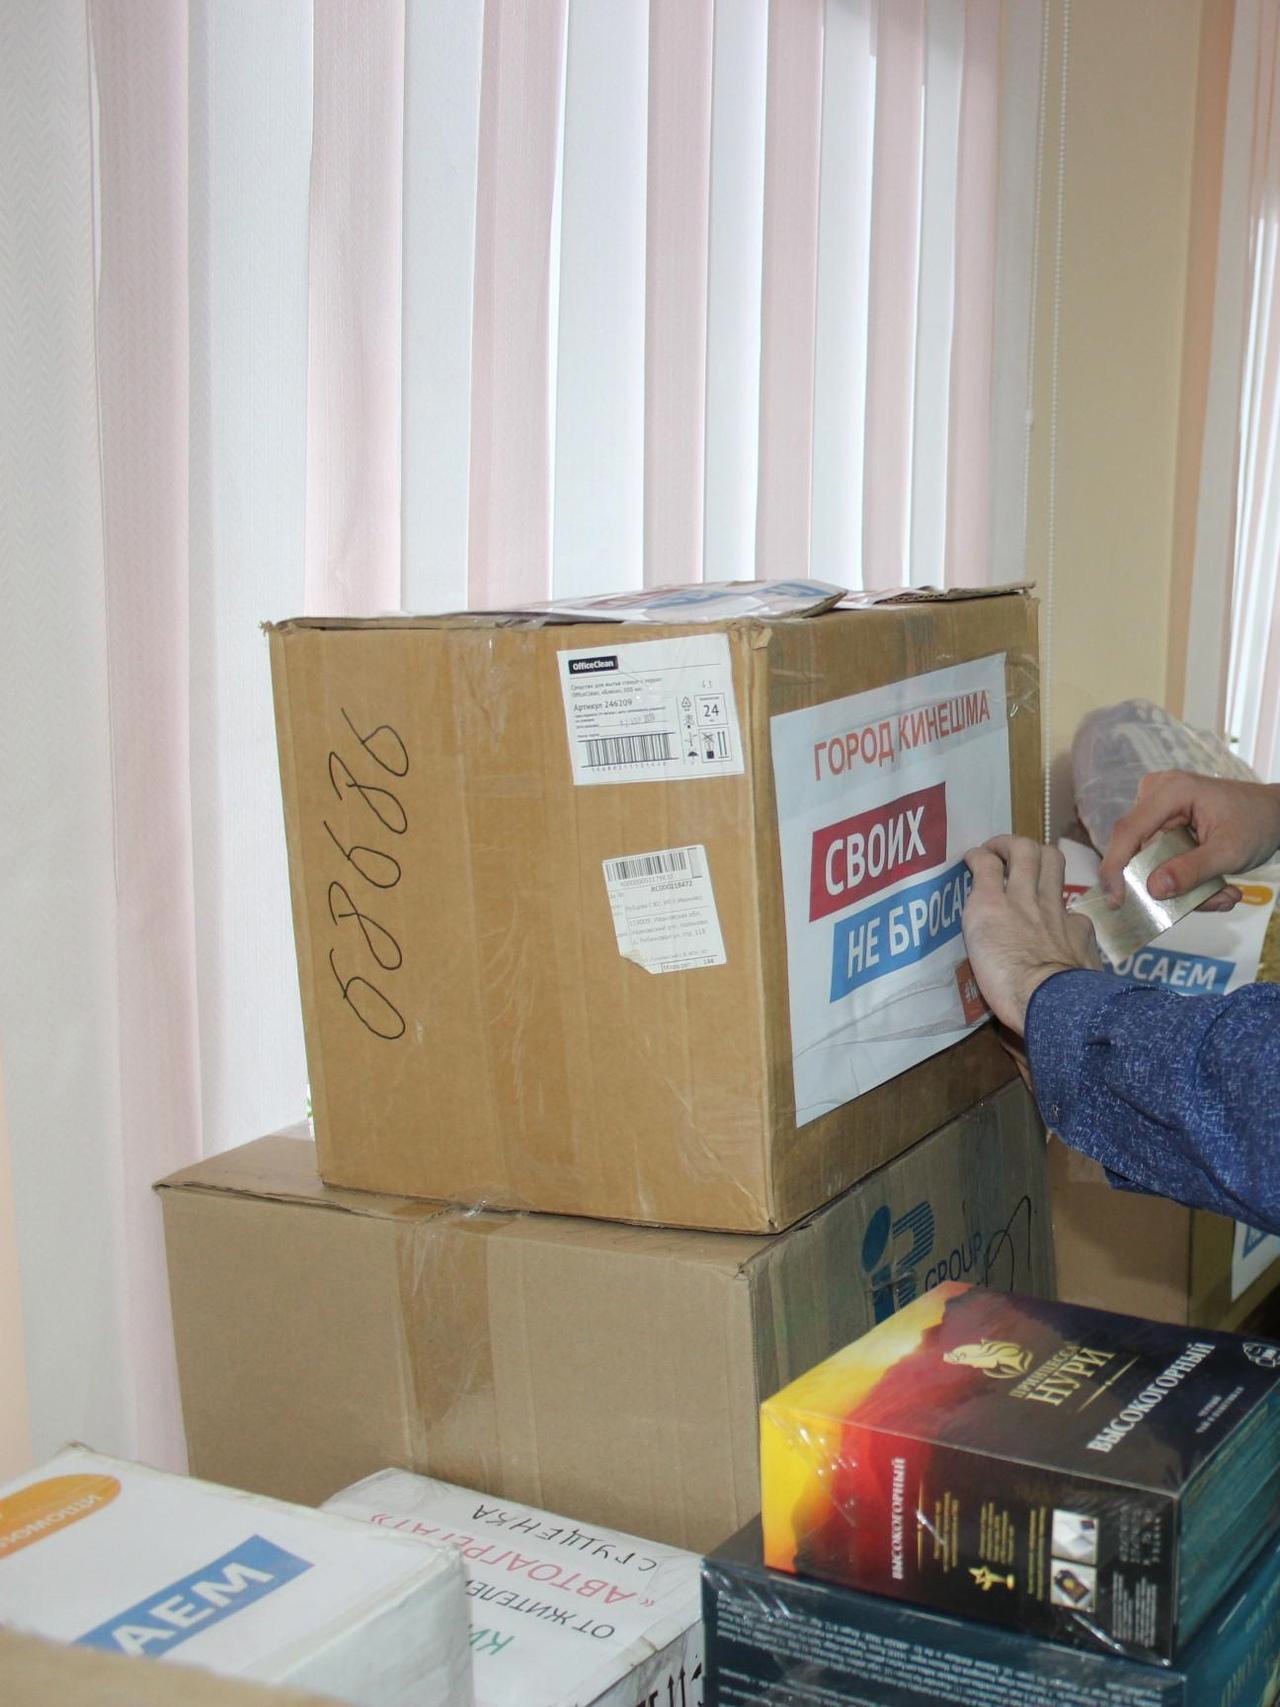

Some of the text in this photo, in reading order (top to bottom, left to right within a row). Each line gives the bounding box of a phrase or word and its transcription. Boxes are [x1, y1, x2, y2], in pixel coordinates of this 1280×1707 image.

[572, 659, 614, 671] OfficeClean
[703, 704, 719, 717] 24
[814, 690, 991, 781] ГОРОД КИНЕШМА
[825, 806, 927, 896] СВОИХ
[847, 917, 881, 980] НЕ
[925, 1231, 983, 1293] GROUP
[1025, 1347, 1117, 1408] НУРИ
[1086, 1341, 1216, 1453] ВЫСОКОГОРНЫЙ
[471, 1503, 658, 1572] СГУЩЕНКА
[891, 1457, 907, 1580] ВЫСОКОГОРНЫЙ
[464, 1579, 616, 1640] ОТ ЖИТЕЛЕ
